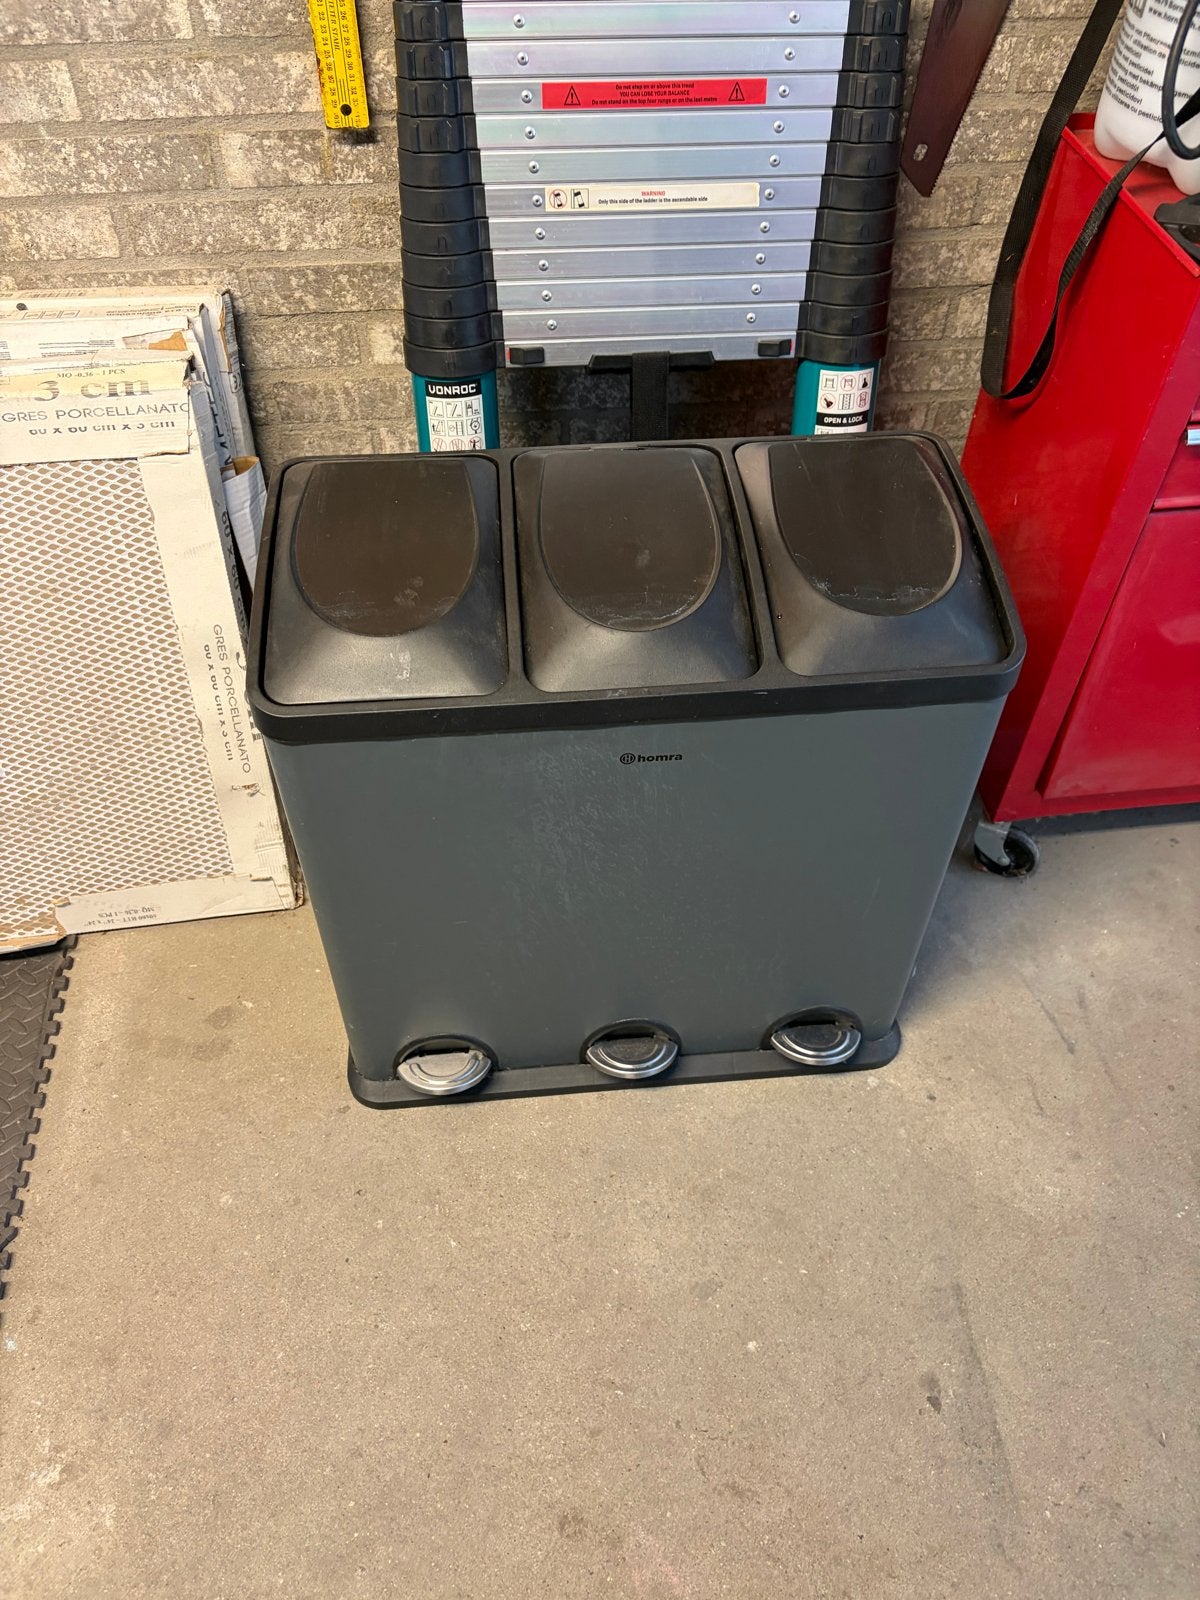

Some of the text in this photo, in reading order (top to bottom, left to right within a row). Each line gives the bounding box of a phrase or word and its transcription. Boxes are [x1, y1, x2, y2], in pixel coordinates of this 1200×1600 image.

[347, 61, 353, 70] 30
[349, 74, 355, 82] 31
[34, 379, 152, 401] 3 cm
[428, 384, 477, 395] VONROC
[2, 410, 48, 423] GRES
[823, 416, 841, 424] OPEN
[848, 415, 863, 423] LOCK
[213, 624, 228, 662] GRES
[222, 666, 251, 774] PORCELLANATO
[637, 753, 683, 762] homra
